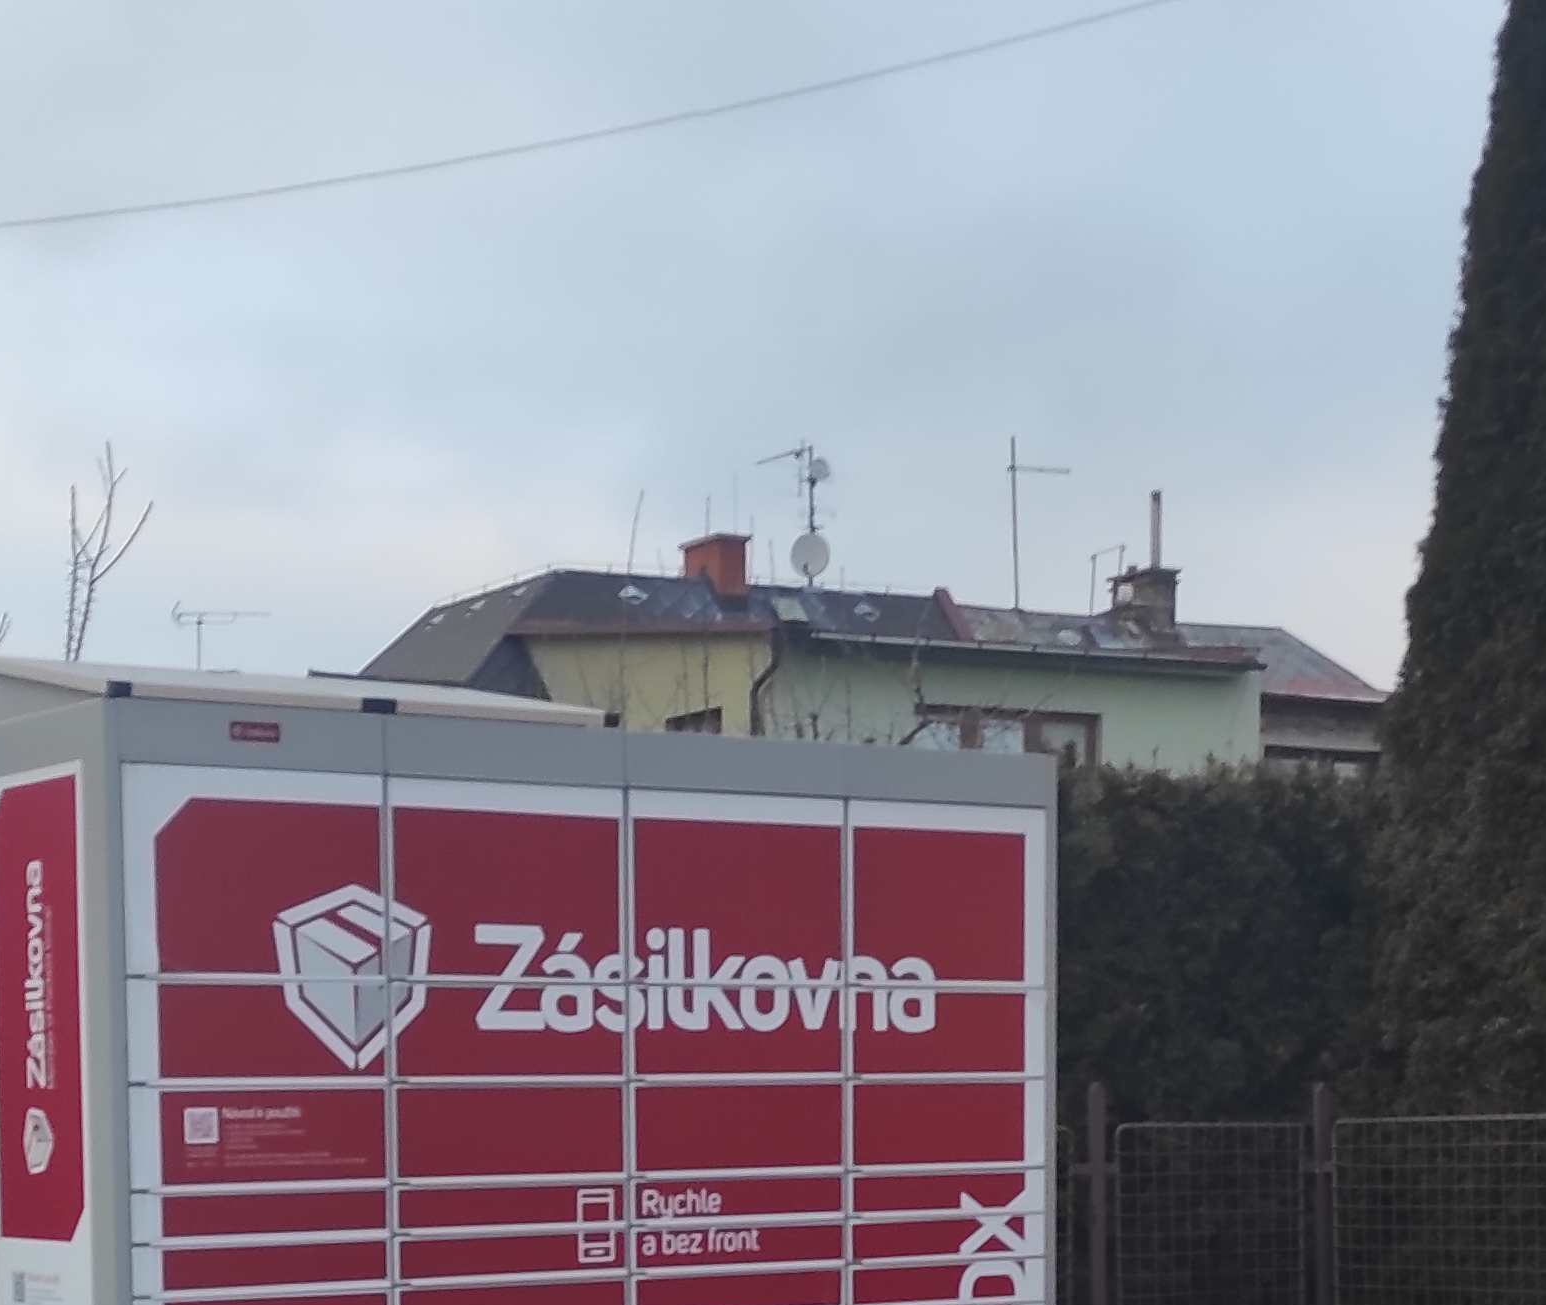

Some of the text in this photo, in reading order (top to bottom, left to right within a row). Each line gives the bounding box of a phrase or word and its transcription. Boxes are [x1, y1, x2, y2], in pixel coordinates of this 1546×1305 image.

[473, 923, 937, 1034] Zásilkovna
[641, 1187, 722, 1219] Rychle
[641, 1227, 761, 1256] a bez front
